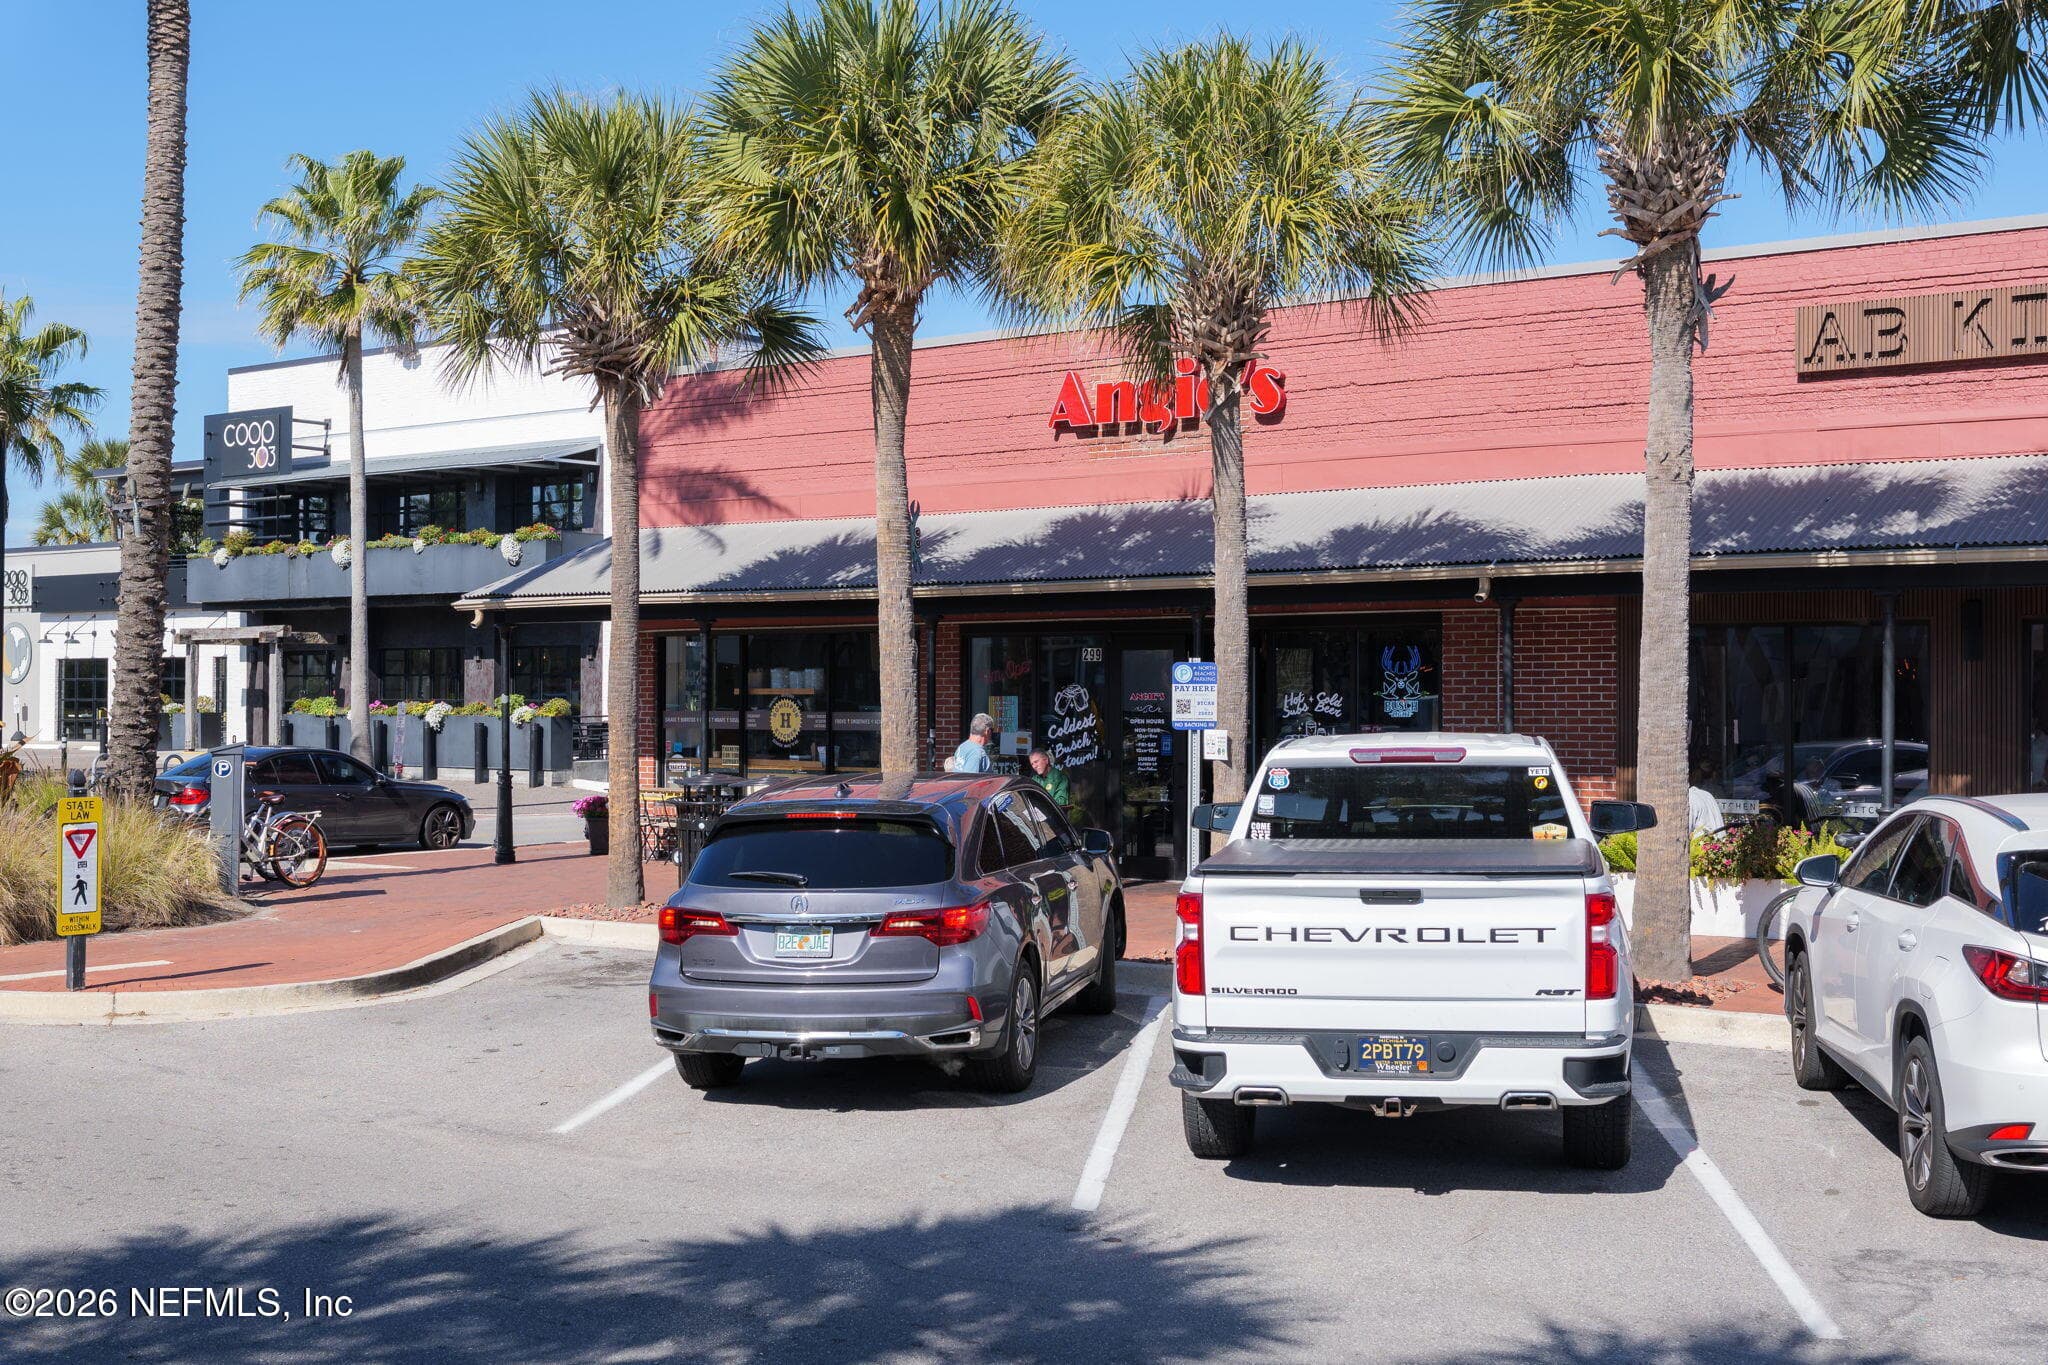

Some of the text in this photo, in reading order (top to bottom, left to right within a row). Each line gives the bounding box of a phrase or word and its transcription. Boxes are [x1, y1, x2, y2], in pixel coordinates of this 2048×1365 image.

[1804, 306, 1909, 364] AB
[247, 446, 276, 469] 303
[1083, 648, 1101, 660] 299
[1284, 691, 1305, 706] Hot
[1316, 691, 1343, 707] Cold
[1384, 700, 1419, 712] BUSCH
[1282, 702, 1309, 718] Subs
[1314, 702, 1342, 717] Beer
[780, 712, 792, 729] H
[1047, 712, 1097, 739] Coldest
[1055, 731, 1092, 758] Busch
[1064, 745, 1099, 767] town!
[218, 762, 230, 776] P
[66, 801, 95, 810] STATE
[1716, 801, 1756, 810] TCHEN
[70, 811, 90, 820] LAW
[1250, 822, 1271, 830] COME
[69, 915, 90, 923] WITHIN
[61, 923, 97, 933] CROSSWALK
[1230, 926, 1556, 944] CHEVROLET
[1211, 987, 1298, 995] SILVERADO
[1362, 1043, 1424, 1060] 2PBT79
[1375, 1063, 1412, 1071] Wheeler
